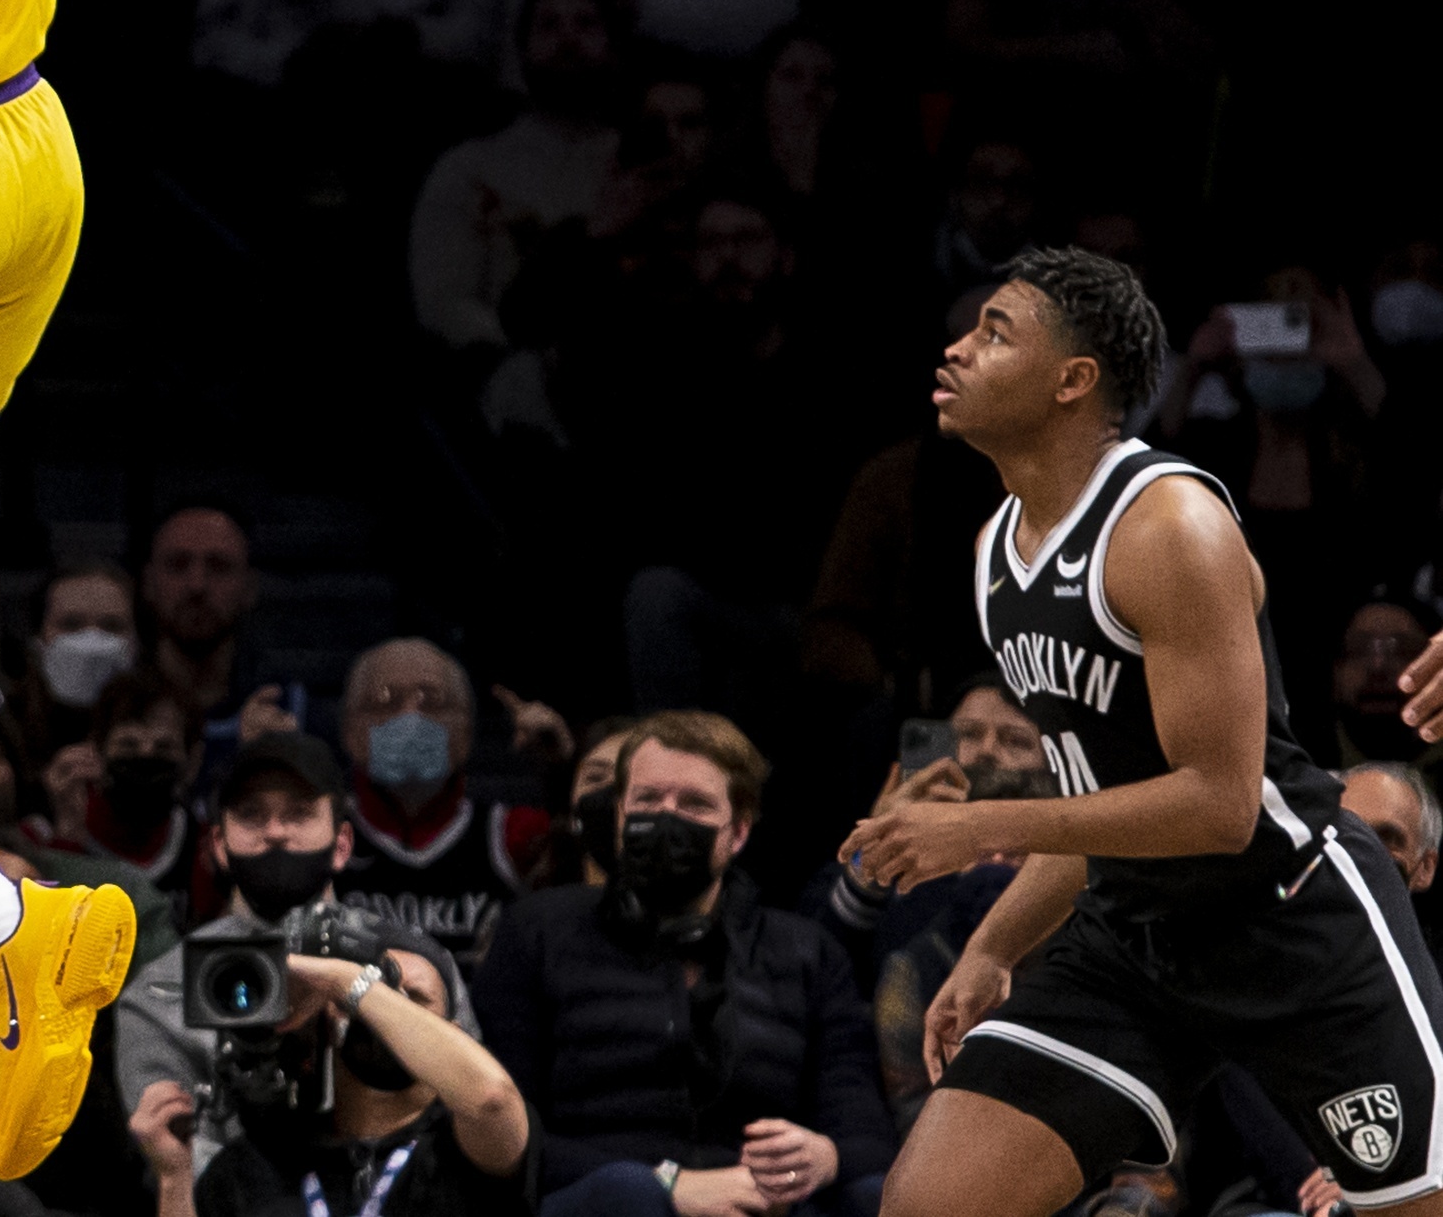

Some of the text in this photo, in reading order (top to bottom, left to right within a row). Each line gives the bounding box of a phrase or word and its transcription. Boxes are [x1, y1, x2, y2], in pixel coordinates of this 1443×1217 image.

[995, 631, 1123, 714] OOKLYN
[1325, 1088, 1399, 1136] NETS
[1362, 1130, 1382, 1159] B
